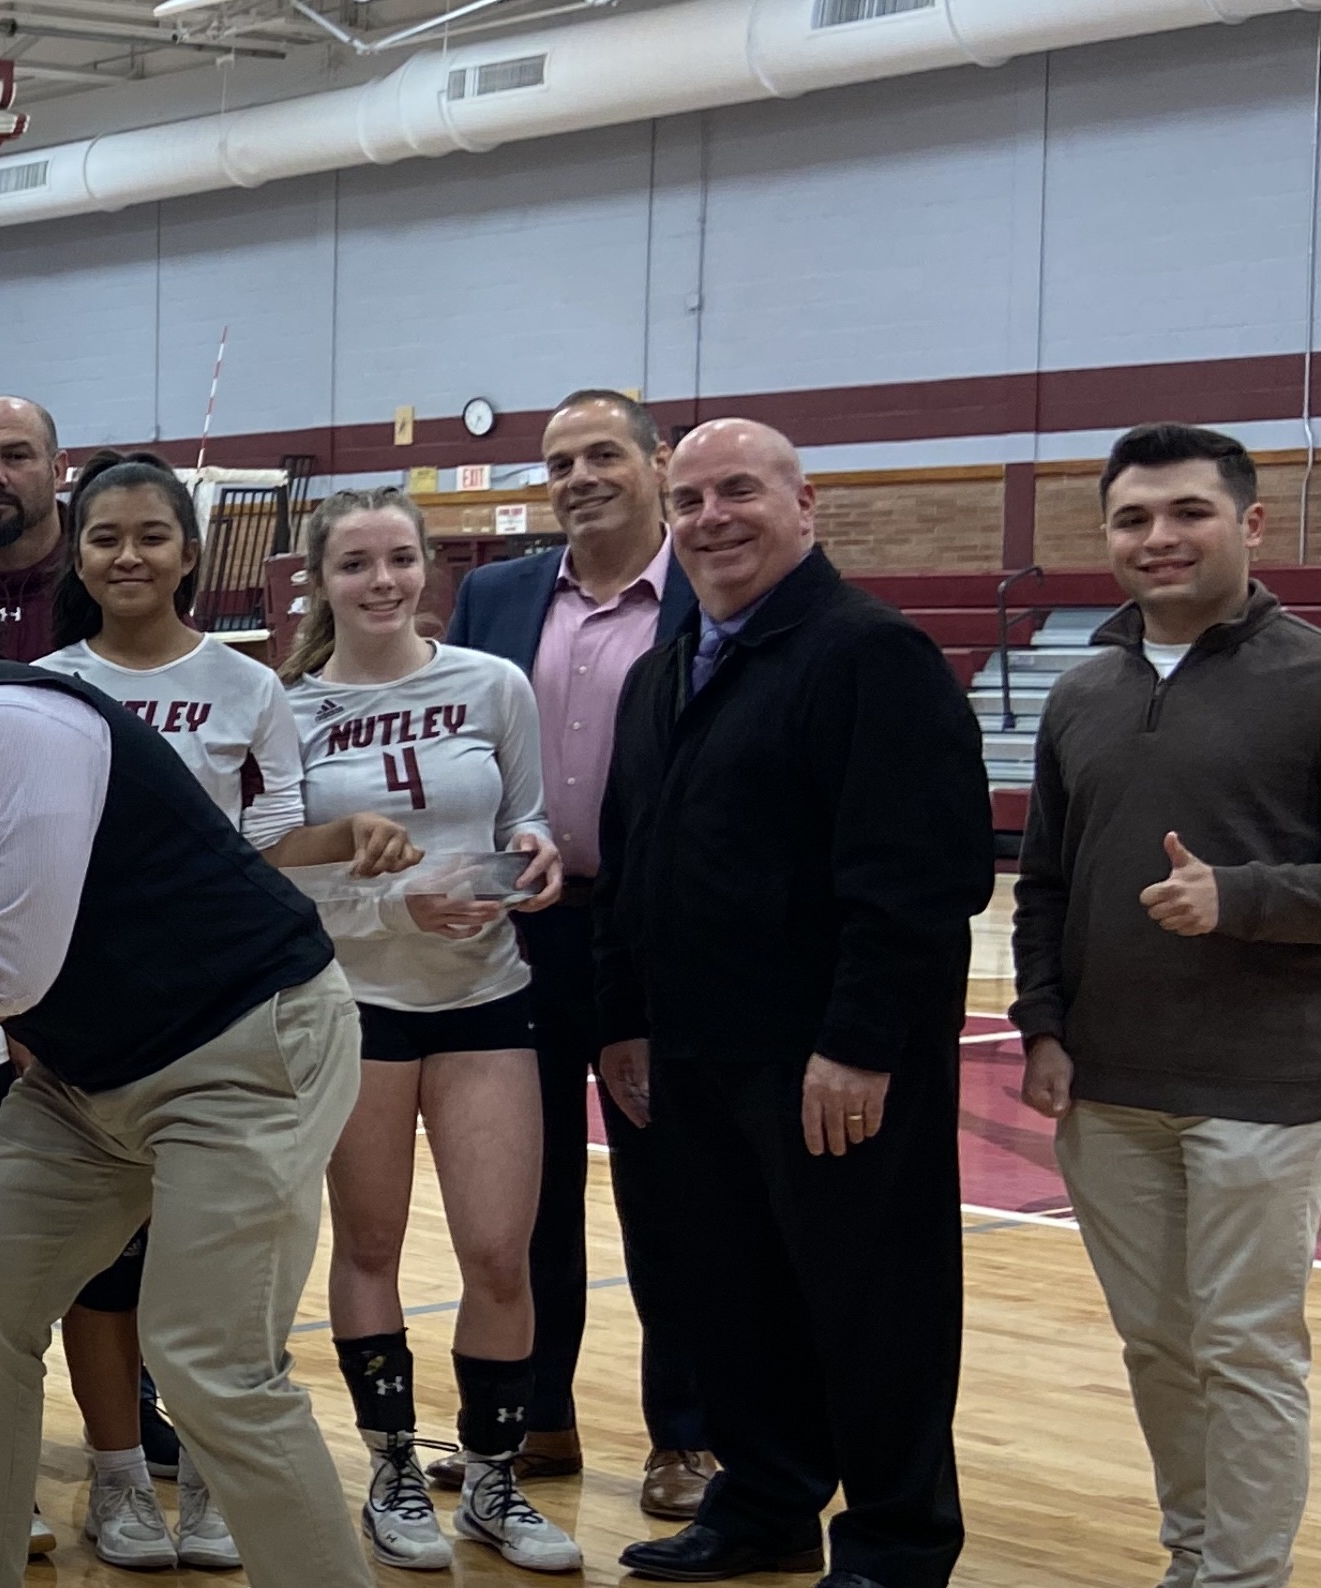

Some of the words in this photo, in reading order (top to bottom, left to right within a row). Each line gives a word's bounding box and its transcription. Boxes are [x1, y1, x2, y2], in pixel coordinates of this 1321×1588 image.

[461, 467, 486, 489] EXIT
[122, 700, 212, 733] TLEY
[326, 703, 468, 757] NUTLEY
[382, 746, 427, 810] 4
